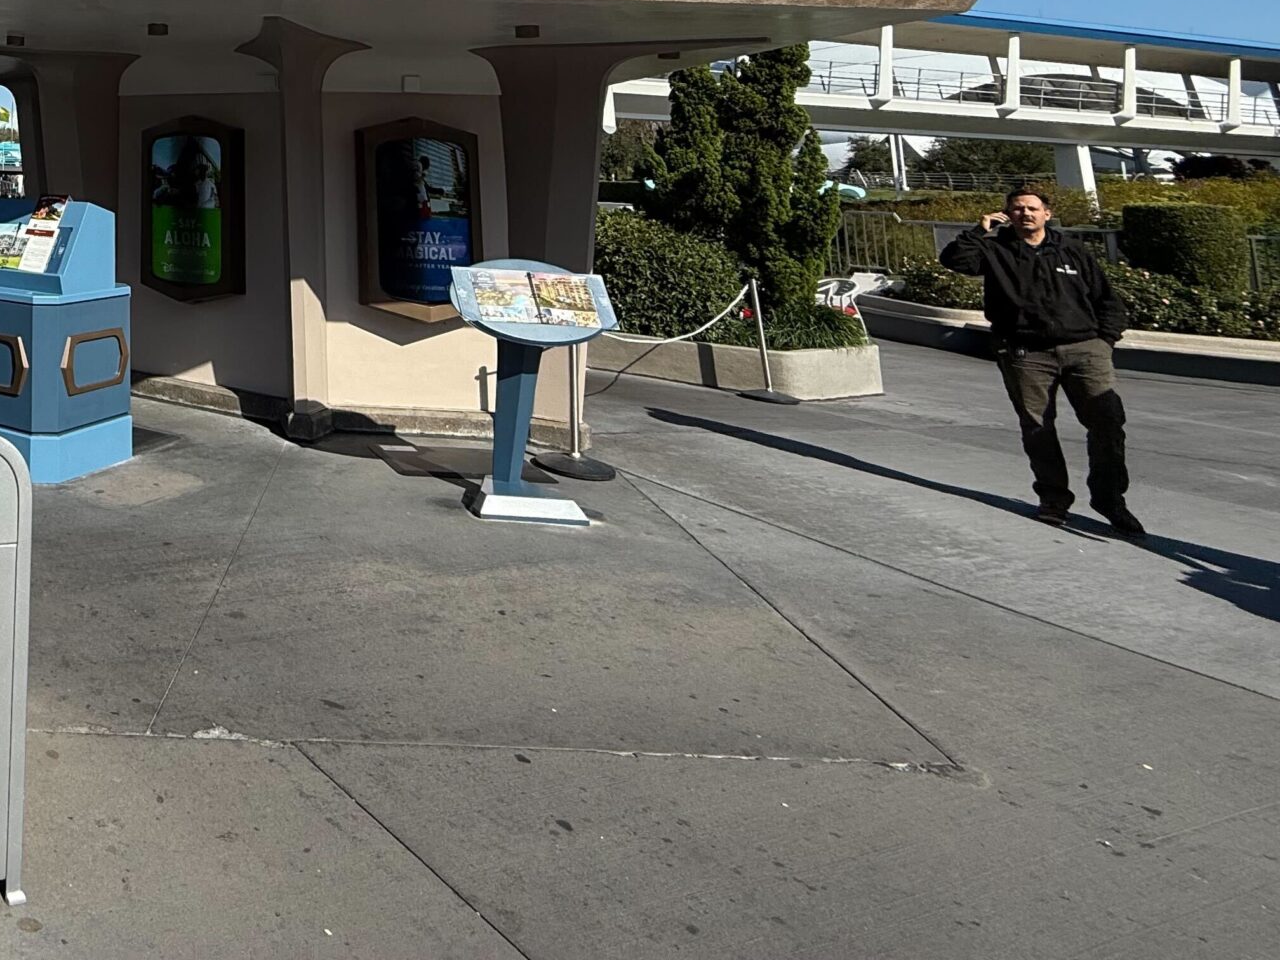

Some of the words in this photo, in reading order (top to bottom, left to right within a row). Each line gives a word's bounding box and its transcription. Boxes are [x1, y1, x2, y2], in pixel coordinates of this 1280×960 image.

[178, 217, 197, 229] SAY
[164, 230, 211, 248] ALOHA
[407, 231, 441, 245] STAY
